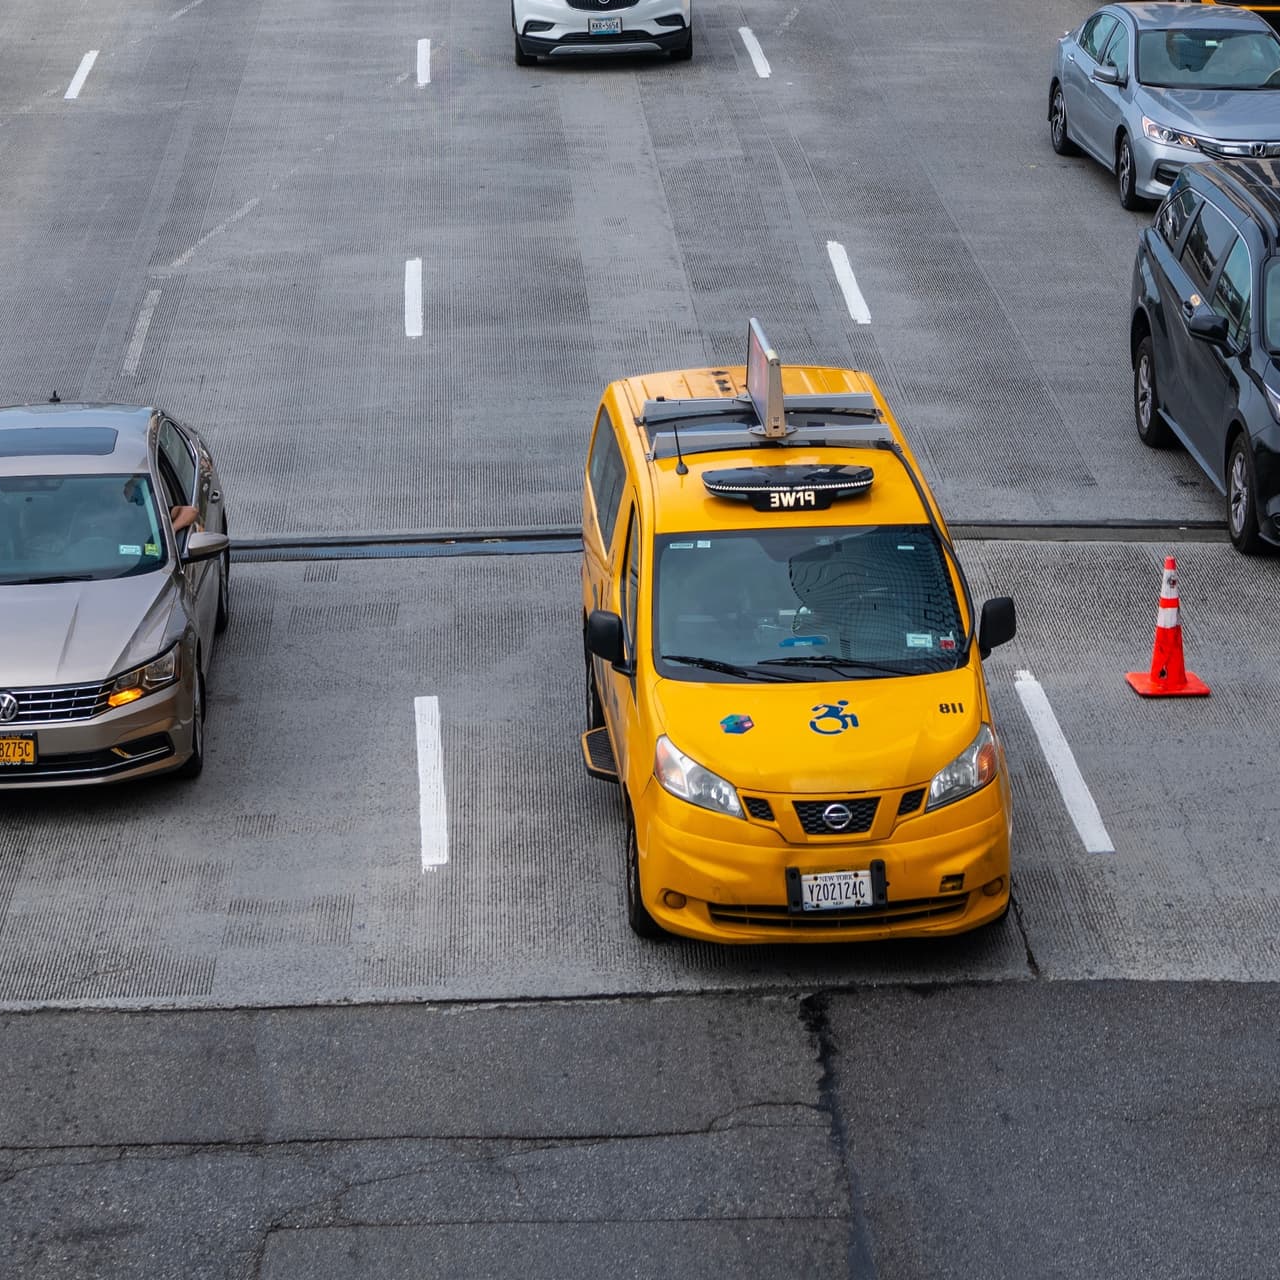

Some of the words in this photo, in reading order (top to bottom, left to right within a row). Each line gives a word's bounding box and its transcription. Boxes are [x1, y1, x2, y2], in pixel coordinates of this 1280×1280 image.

[770, 491, 815, 508] 3W19
[836, 873, 854, 881] YORK
[808, 880, 866, 902] Y202124C
